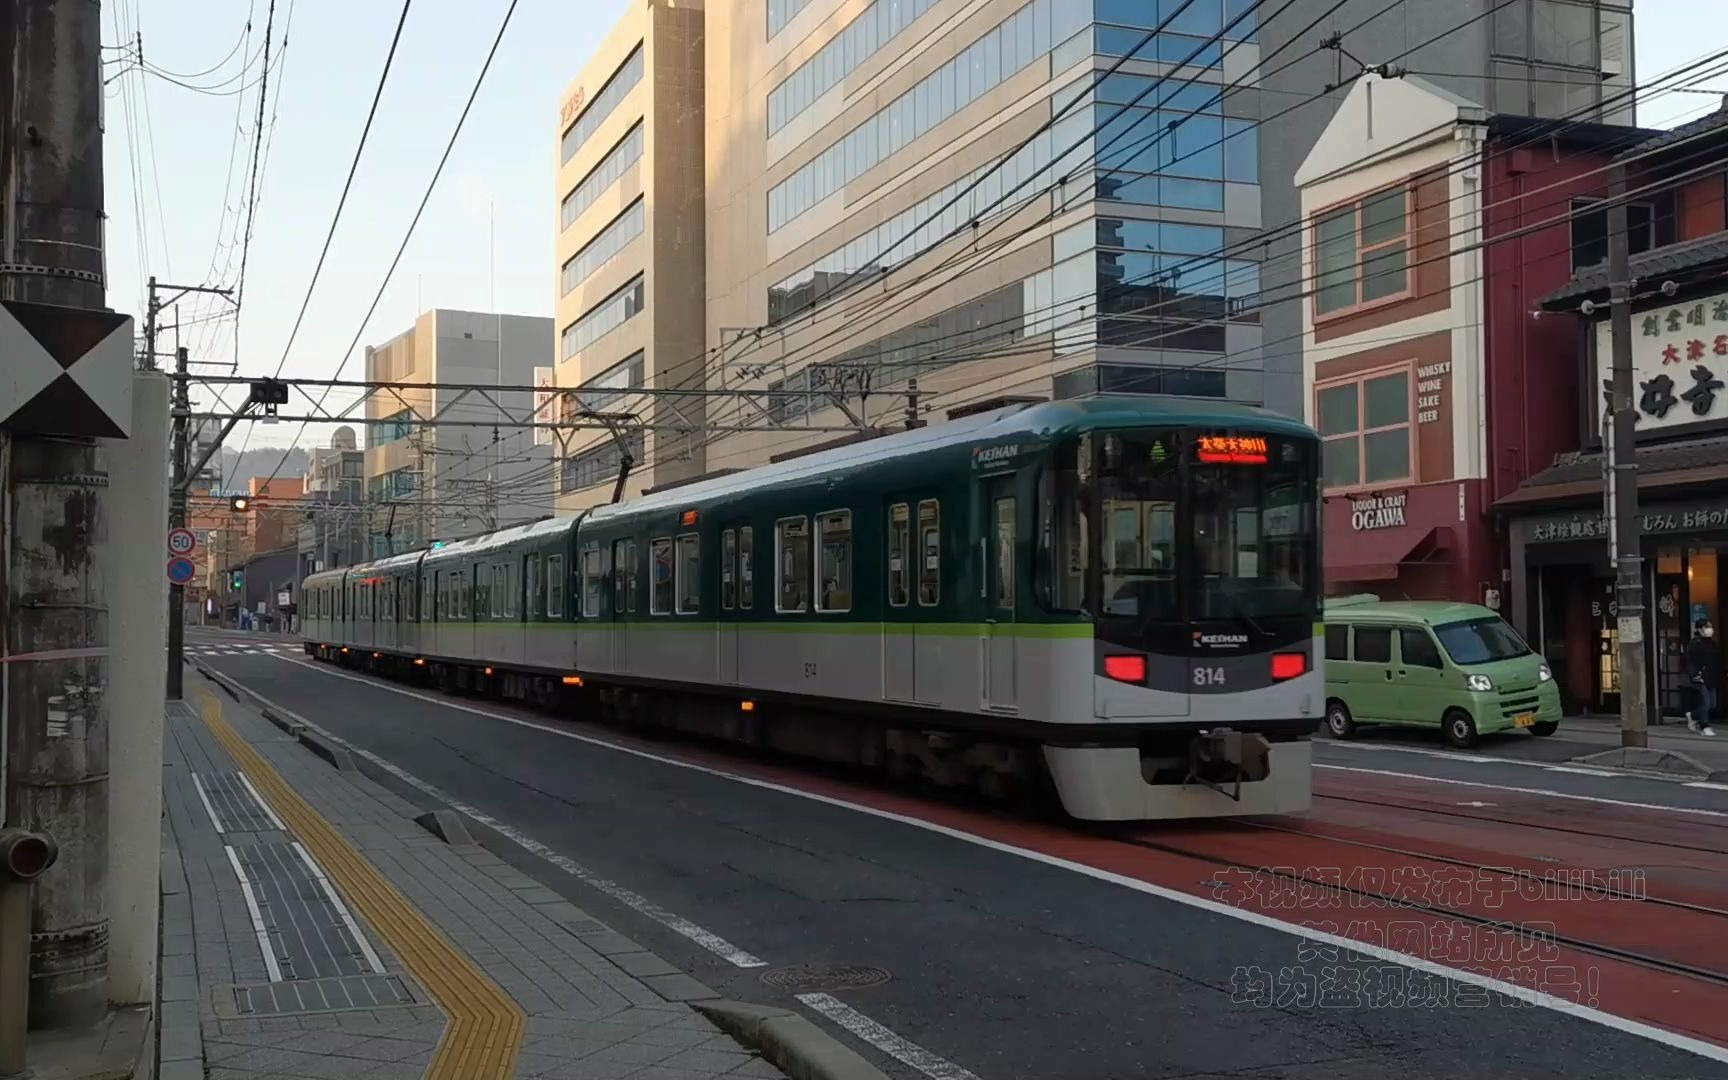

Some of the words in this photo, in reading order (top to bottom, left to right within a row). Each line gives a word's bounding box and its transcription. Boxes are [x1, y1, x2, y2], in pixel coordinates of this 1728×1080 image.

[1417, 361, 1450, 378] WHISKY
[1417, 379, 1441, 392] WINE
[1418, 395, 1440, 408] SAKE
[1418, 410, 1438, 423] BEER
[978, 444, 1018, 462] KEIHAN
[1352, 499, 1376, 512] LIQUOR
[1377, 497, 1383, 509] &
[1385, 495, 1406, 507] CRAFT
[1351, 507, 1406, 530] OGAWA
[172, 536, 190, 549] 50
[1201, 634, 1249, 643] KEIHAN
[1193, 667, 1226, 685] 814
